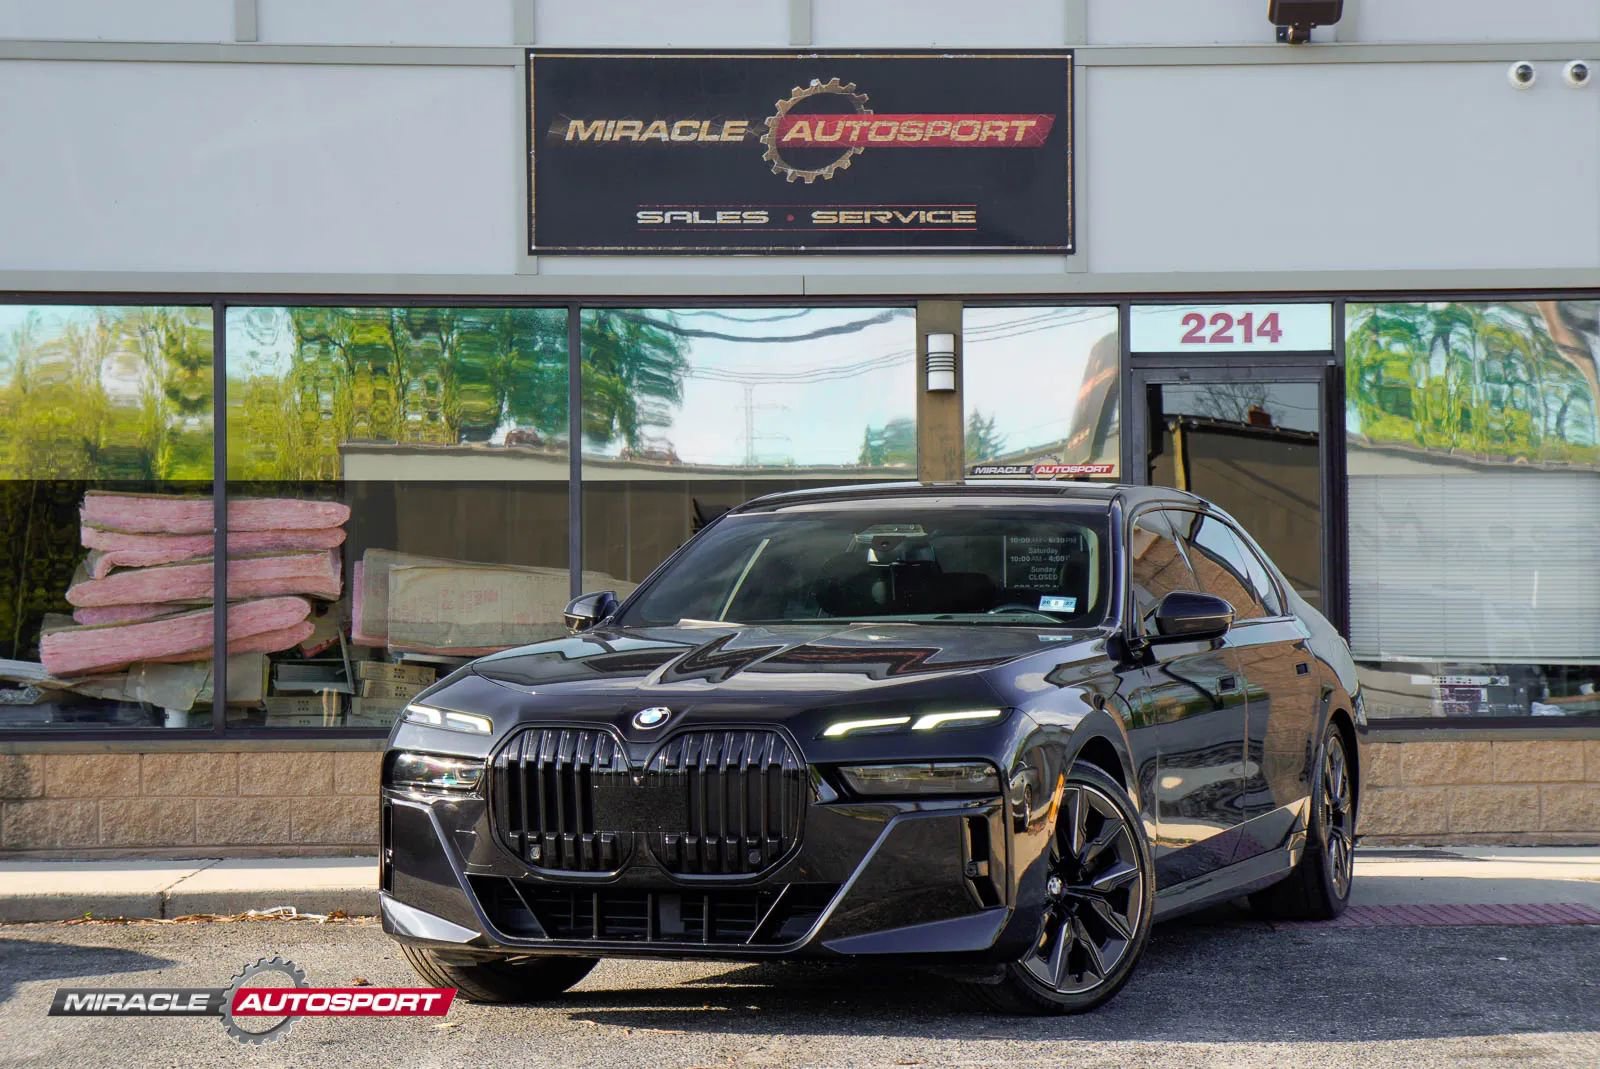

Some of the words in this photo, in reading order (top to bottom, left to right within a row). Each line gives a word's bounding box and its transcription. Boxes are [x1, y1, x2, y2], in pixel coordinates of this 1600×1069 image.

[564, 118, 749, 143] MIRACLE
[782, 118, 1037, 143] AUTOSPORT
[636, 210, 769, 225] SALES
[811, 210, 977, 225] SERVICE
[1180, 312, 1283, 344] 2214
[974, 466, 1028, 475] MIRACLE
[1036, 465, 1110, 474] AUTOSPORT
[1028, 547, 1059, 555] Saturday
[1031, 566, 1057, 574] Sunday
[1028, 573, 1058, 581] CLOSED
